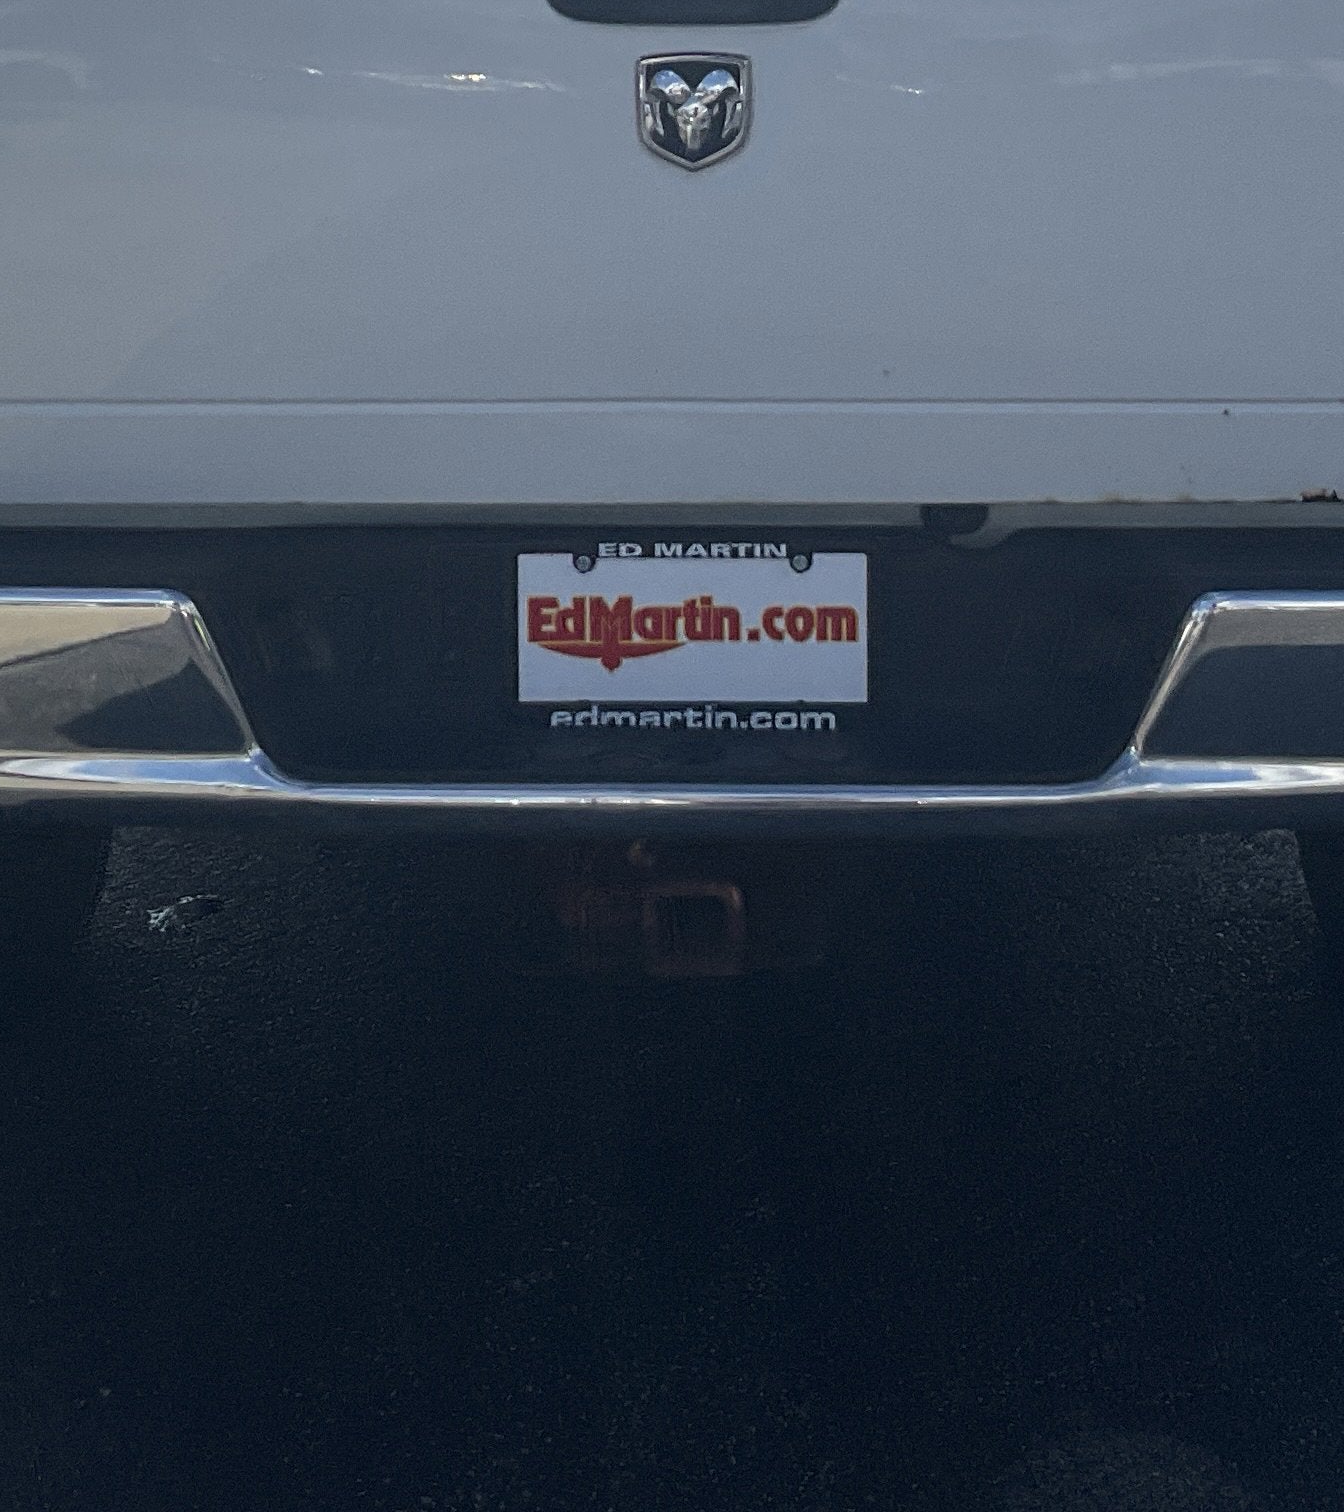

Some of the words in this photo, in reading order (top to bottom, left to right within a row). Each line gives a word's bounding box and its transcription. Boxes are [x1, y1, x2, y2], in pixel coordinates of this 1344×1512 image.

[598, 542, 642, 558] ED
[654, 542, 788, 558] MARTIN
[526, 594, 859, 644] EdMartin.com
[550, 705, 837, 730] edmartin.com
